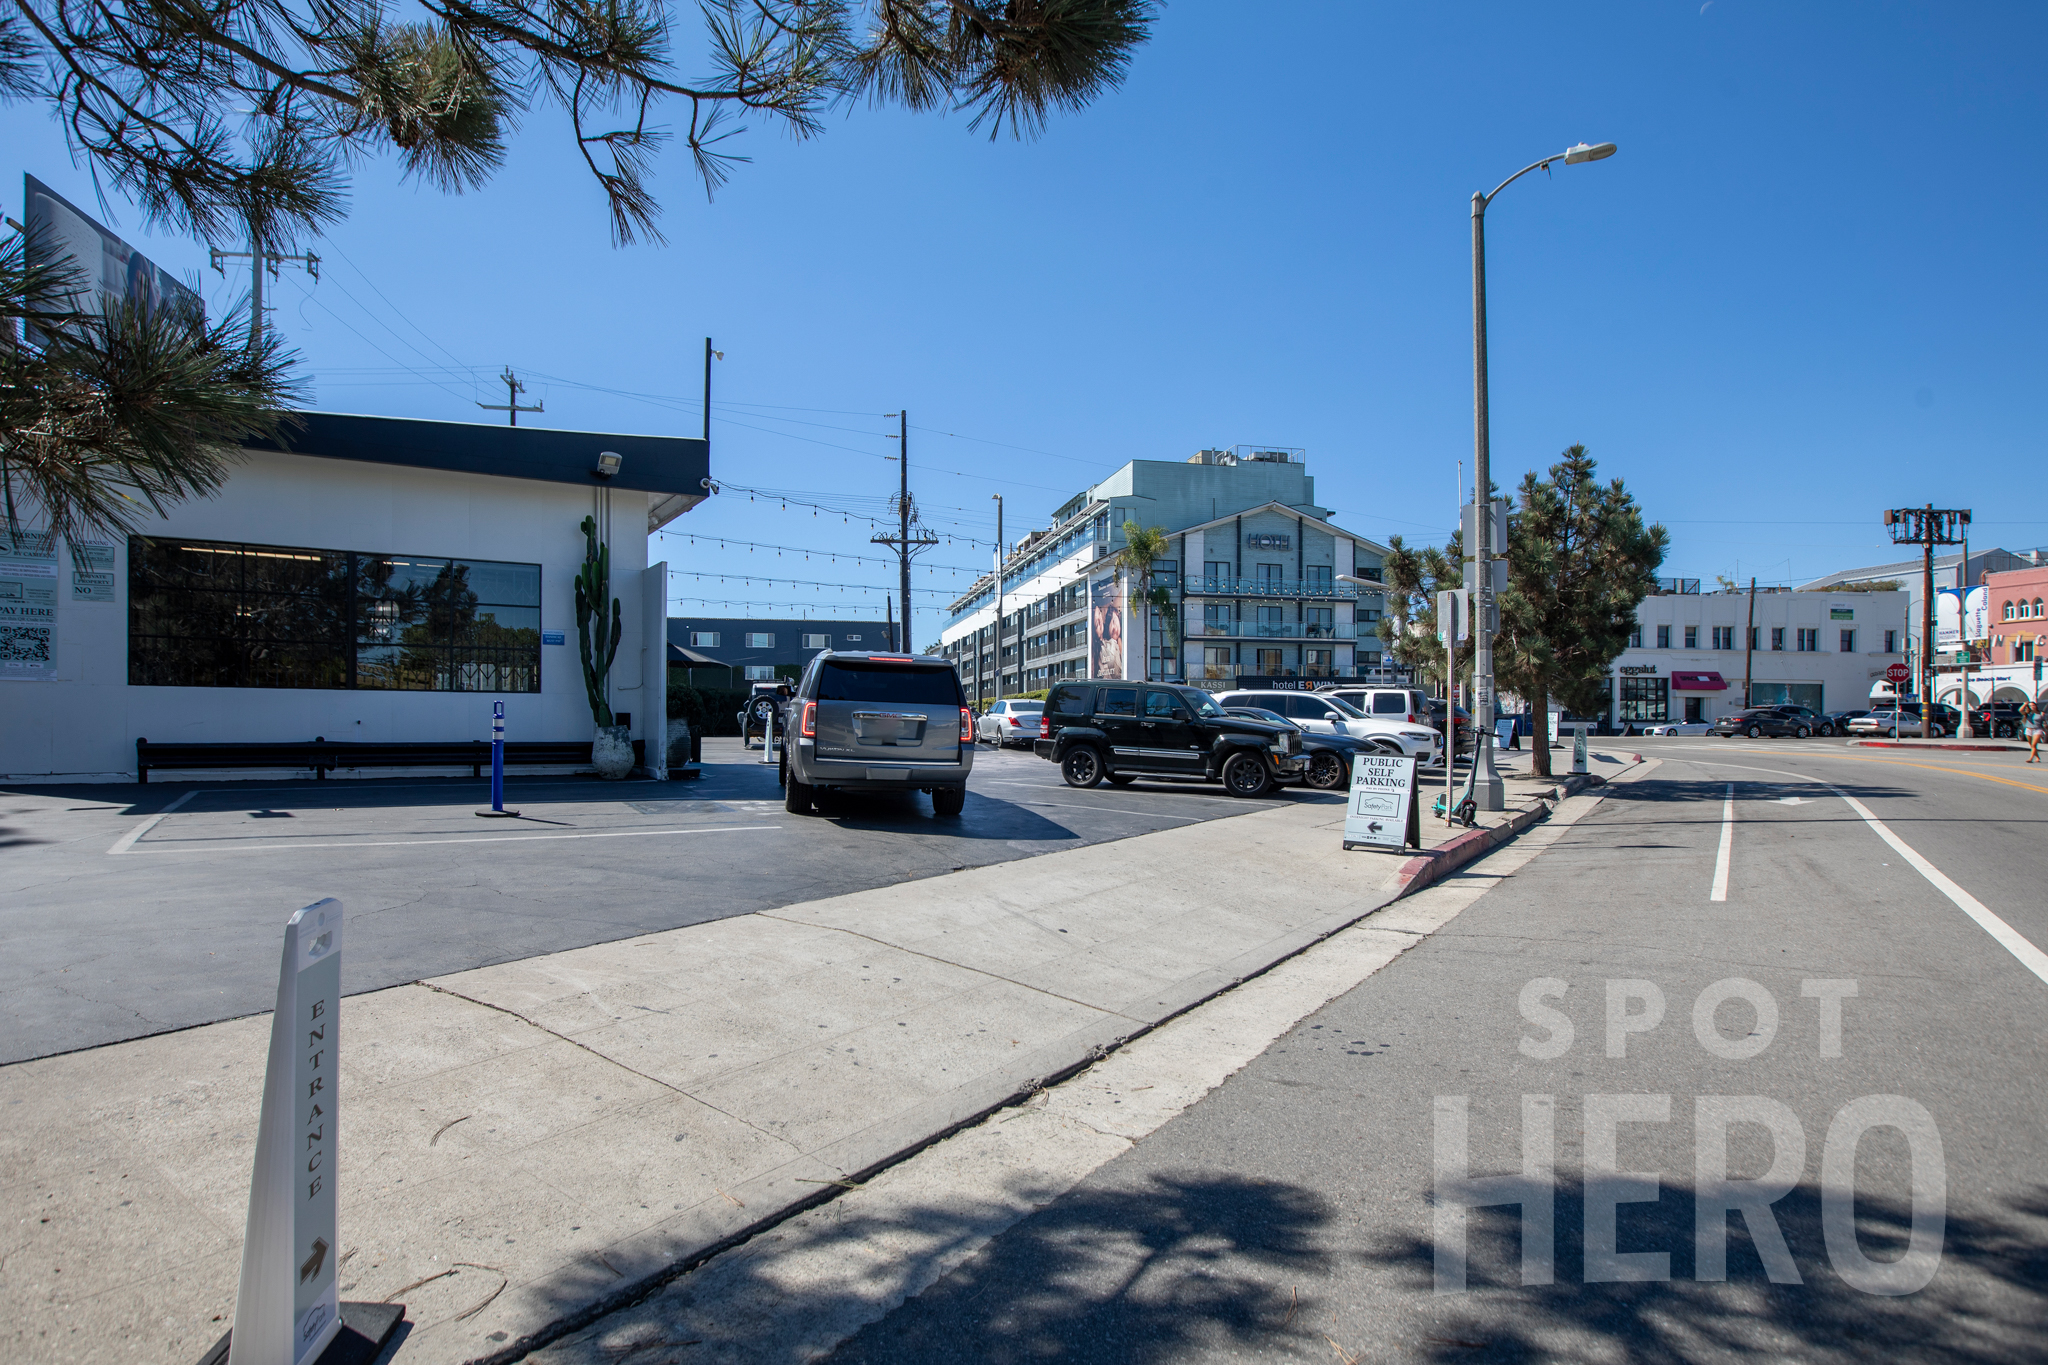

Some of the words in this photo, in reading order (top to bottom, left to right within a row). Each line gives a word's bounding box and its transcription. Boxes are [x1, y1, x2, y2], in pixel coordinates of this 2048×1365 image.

[75, 586, 92, 594] NO
[20, 607, 54, 616] HERE
[1620, 664, 1657, 676] eggslut
[1888, 669, 1908, 677] STOP
[1201, 681, 1226, 689] KASSI
[1272, 681, 1296, 690] hotel
[1363, 757, 1403, 768] PUBLIC
[1368, 767, 1394, 777] SELF
[1356, 776, 1406, 788] PARKING
[308, 999, 325, 1201] ENTRANCE
